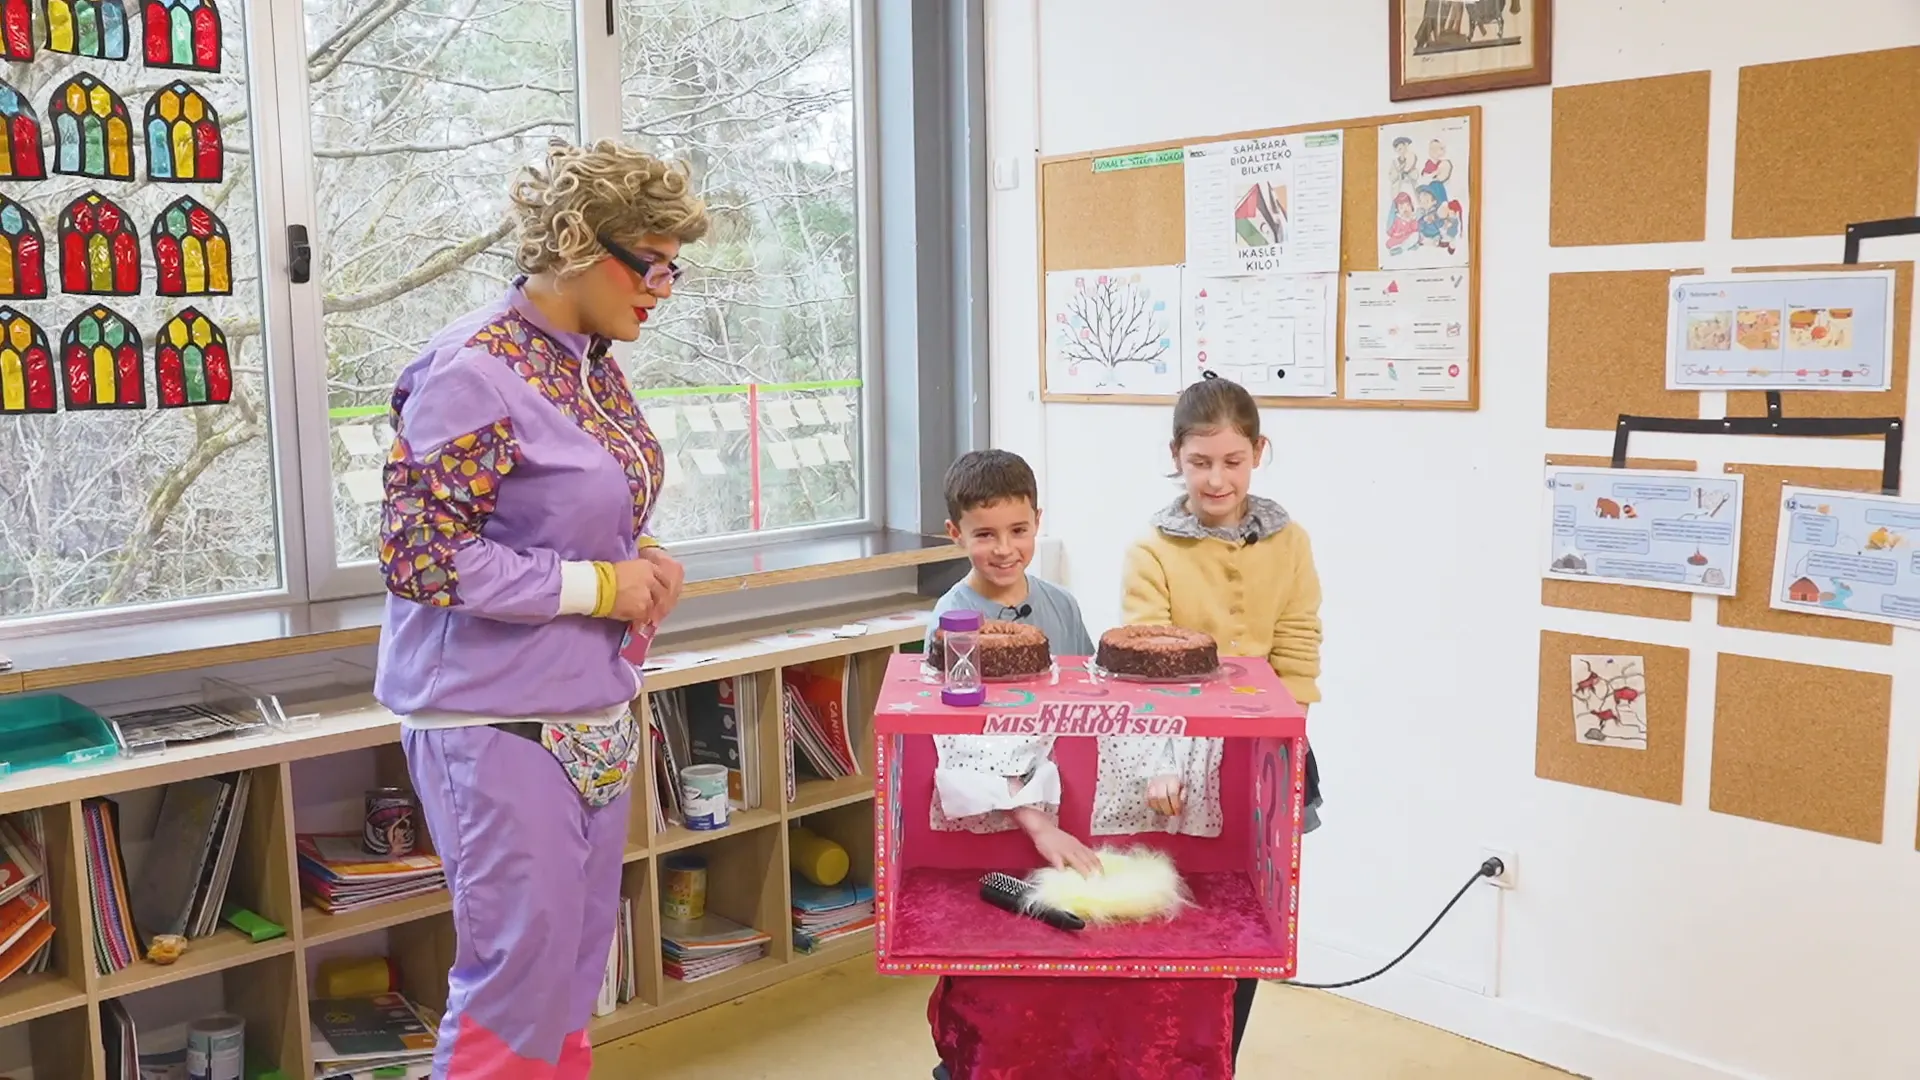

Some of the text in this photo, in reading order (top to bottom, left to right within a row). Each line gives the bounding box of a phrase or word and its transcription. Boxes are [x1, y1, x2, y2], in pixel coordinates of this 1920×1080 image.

[1233, 138, 1288, 154] SAHARARA
[1230, 149, 1292, 166] BIDALTZEKO
[1241, 163, 1282, 176] BILKETA
[1238, 246, 1277, 259] IKASLE
[1246, 259, 1273, 271] KILO
[1038, 703, 1131, 722] KUTXA
[986, 716, 1184, 734] MISTERIOTSUA
